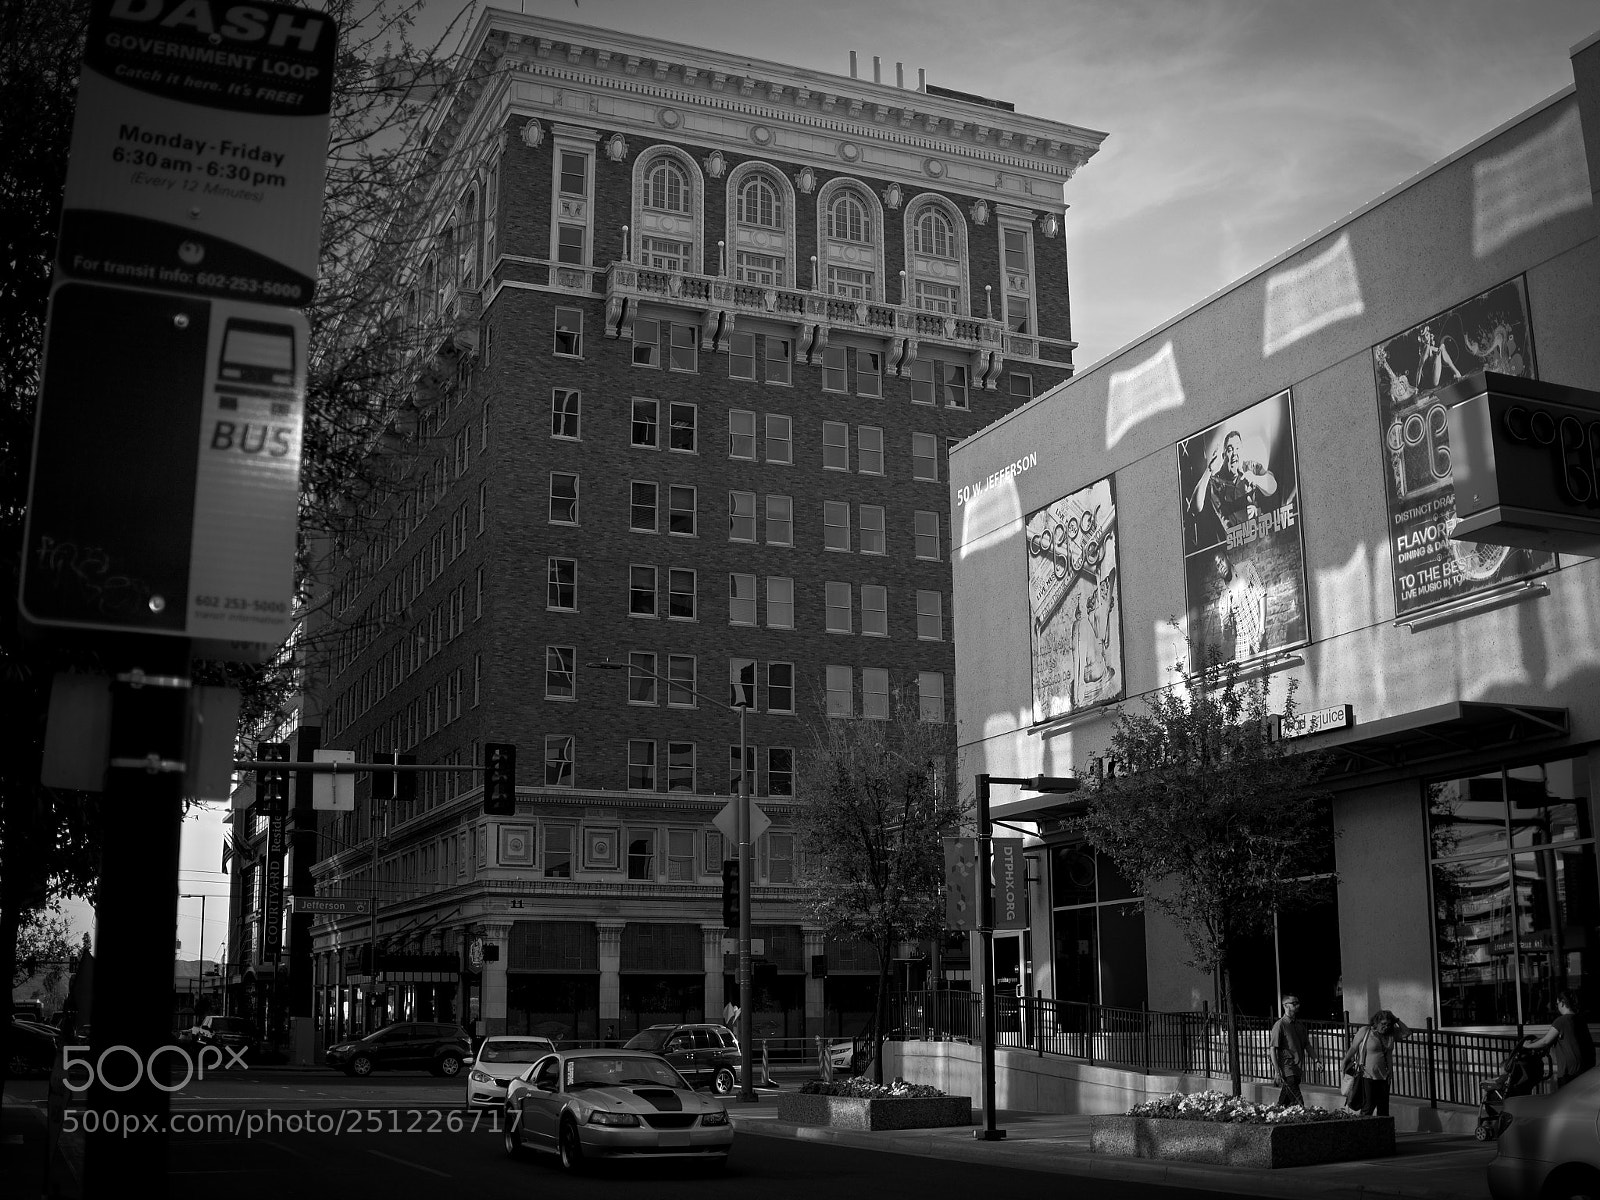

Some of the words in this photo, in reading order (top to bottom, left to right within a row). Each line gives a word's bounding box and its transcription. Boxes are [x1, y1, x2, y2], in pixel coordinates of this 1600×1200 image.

[108, 0, 325, 52] DASH
[105, 32, 257, 71] GOVERNMENT
[261, 58, 320, 81] LOOP
[114, 63, 163, 83] Catch
[166, 71, 179, 85] it
[183, 75, 223, 92] here.
[228, 82, 252, 97] It's
[256, 87, 304, 105] FREE!
[130, 171, 175, 190] (Every
[182, 179, 198, 191] 12
[204, 182, 264, 204] Minutes)
[73, 255, 98, 272] For
[104, 261, 155, 279] transit
[159, 267, 194, 284] info:
[196, 273, 301, 299] 602-253-5000
[211, 421, 293, 458] BUS
[956, 485, 970, 507] 50
[972, 481, 983, 498] W.
[985, 451, 1038, 492] JEFFERSON
[1226, 518, 1257, 551] STAND
[1273, 502, 1295, 533] LIVE
[1395, 502, 1432, 525] DISTINCT
[1433, 493, 1456, 510] DRAF
[1397, 521, 1448, 552] FLAVOR
[1398, 546, 1426, 564] DINING
[1427, 544, 1434, 554] &
[1435, 539, 1452, 551] DAN
[1398, 574, 1415, 591] TO
[1417, 565, 1441, 586] THE
[1443, 558, 1467, 576] BES
[1401, 587, 1417, 601] LIVE
[1418, 580, 1442, 596] MUSIC
[1443, 577, 1451, 588] IN
[1319, 709, 1344, 728] juice
[270, 815, 283, 853] Reside
[1003, 846, 1016, 921] DTPHX.ORG
[267, 861, 281, 945] COURTYARD
[301, 900, 346, 911] Jefferson
[510, 899, 525, 909] 11
